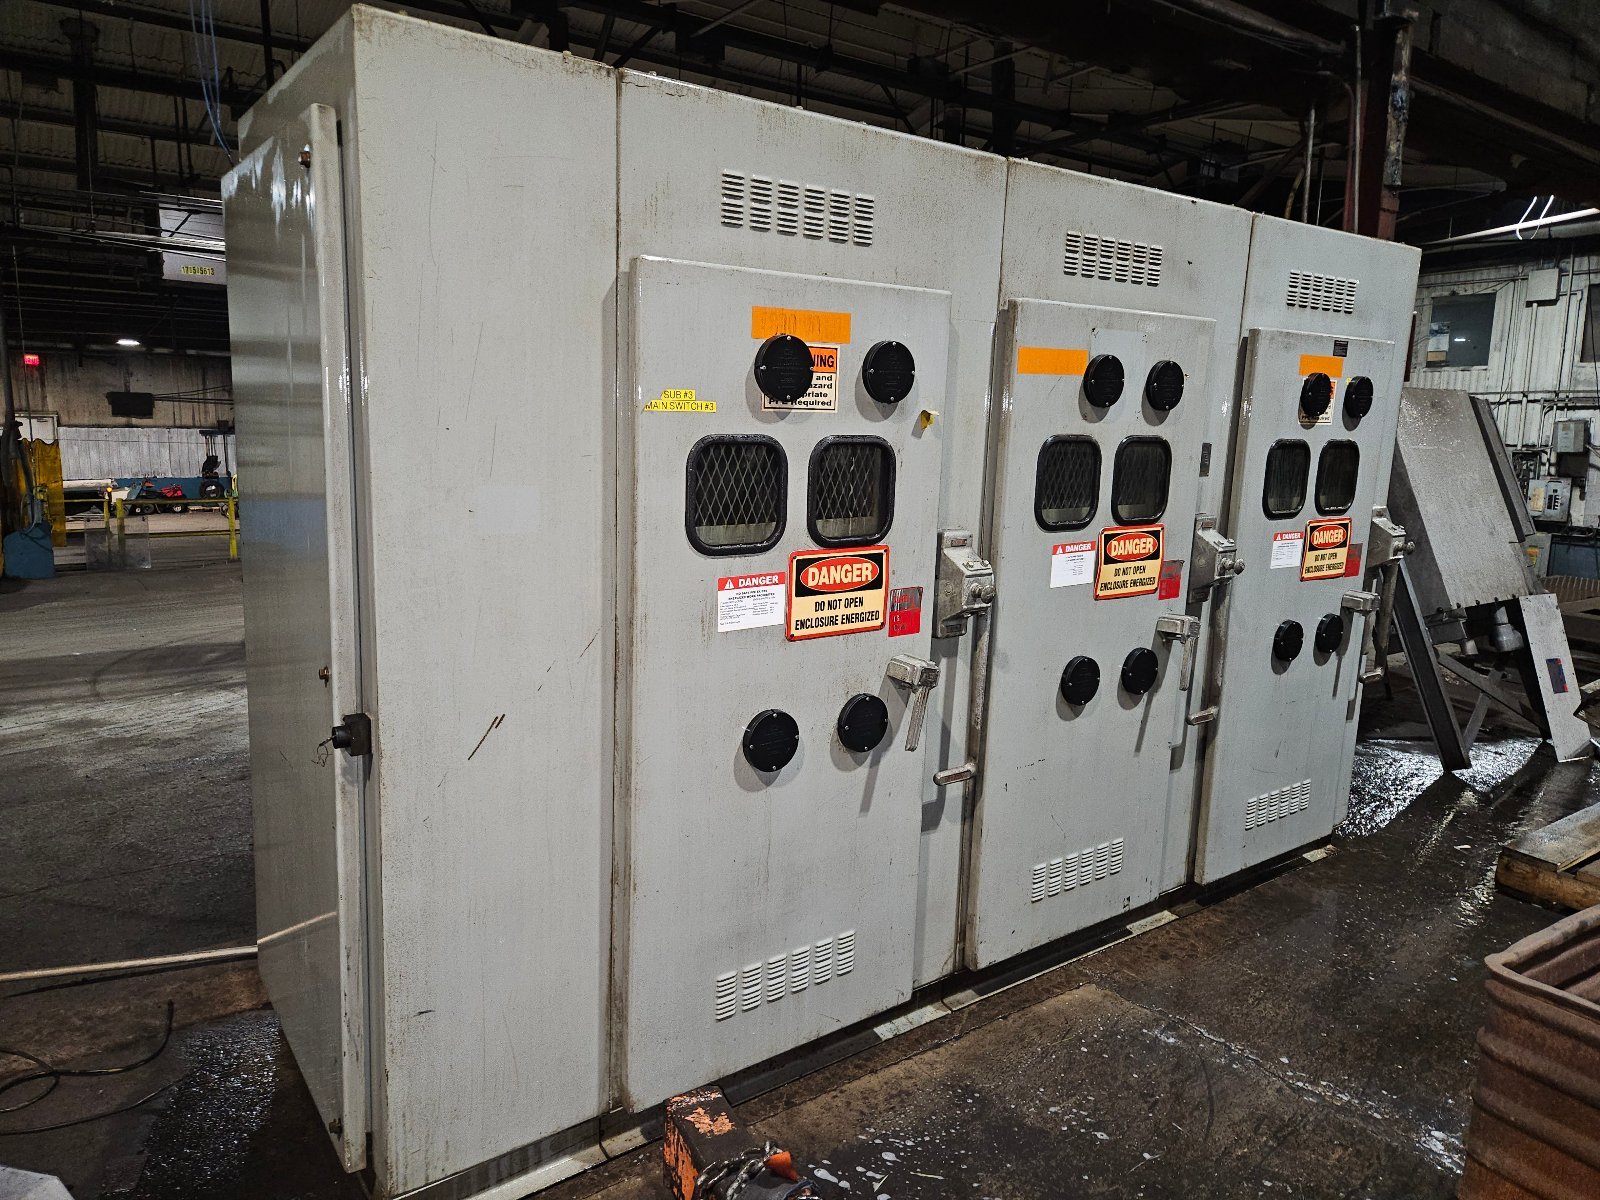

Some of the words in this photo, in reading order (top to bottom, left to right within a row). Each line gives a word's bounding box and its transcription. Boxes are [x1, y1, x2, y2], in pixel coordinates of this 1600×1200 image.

[663, 390, 682, 399] SUB
[683, 390, 693, 399] #3
[645, 401, 668, 410] MAIN
[669, 401, 703, 411] SWITCH
[704, 402, 714, 411] #3
[1314, 529, 1344, 545] DANGER
[1065, 543, 1092, 553] DANGER
[1111, 537, 1154, 556] DANGER
[807, 562, 873, 587] DANGER
[1113, 567, 1122, 577] DO
[1123, 566, 1132, 576] NOT
[1133, 565, 1146, 575] OPEN
[738, 575, 779, 588] DANGER
[1100, 579, 1129, 591] ENCLOSURE
[1130, 577, 1156, 588] ENERGIZED
[814, 600, 825, 612] DO
[828, 598, 842, 611] NOT
[844, 596, 864, 609] OPEN
[795, 615, 839, 630] ENCLOSURE
[841, 610, 880, 625] ENERGIZED
